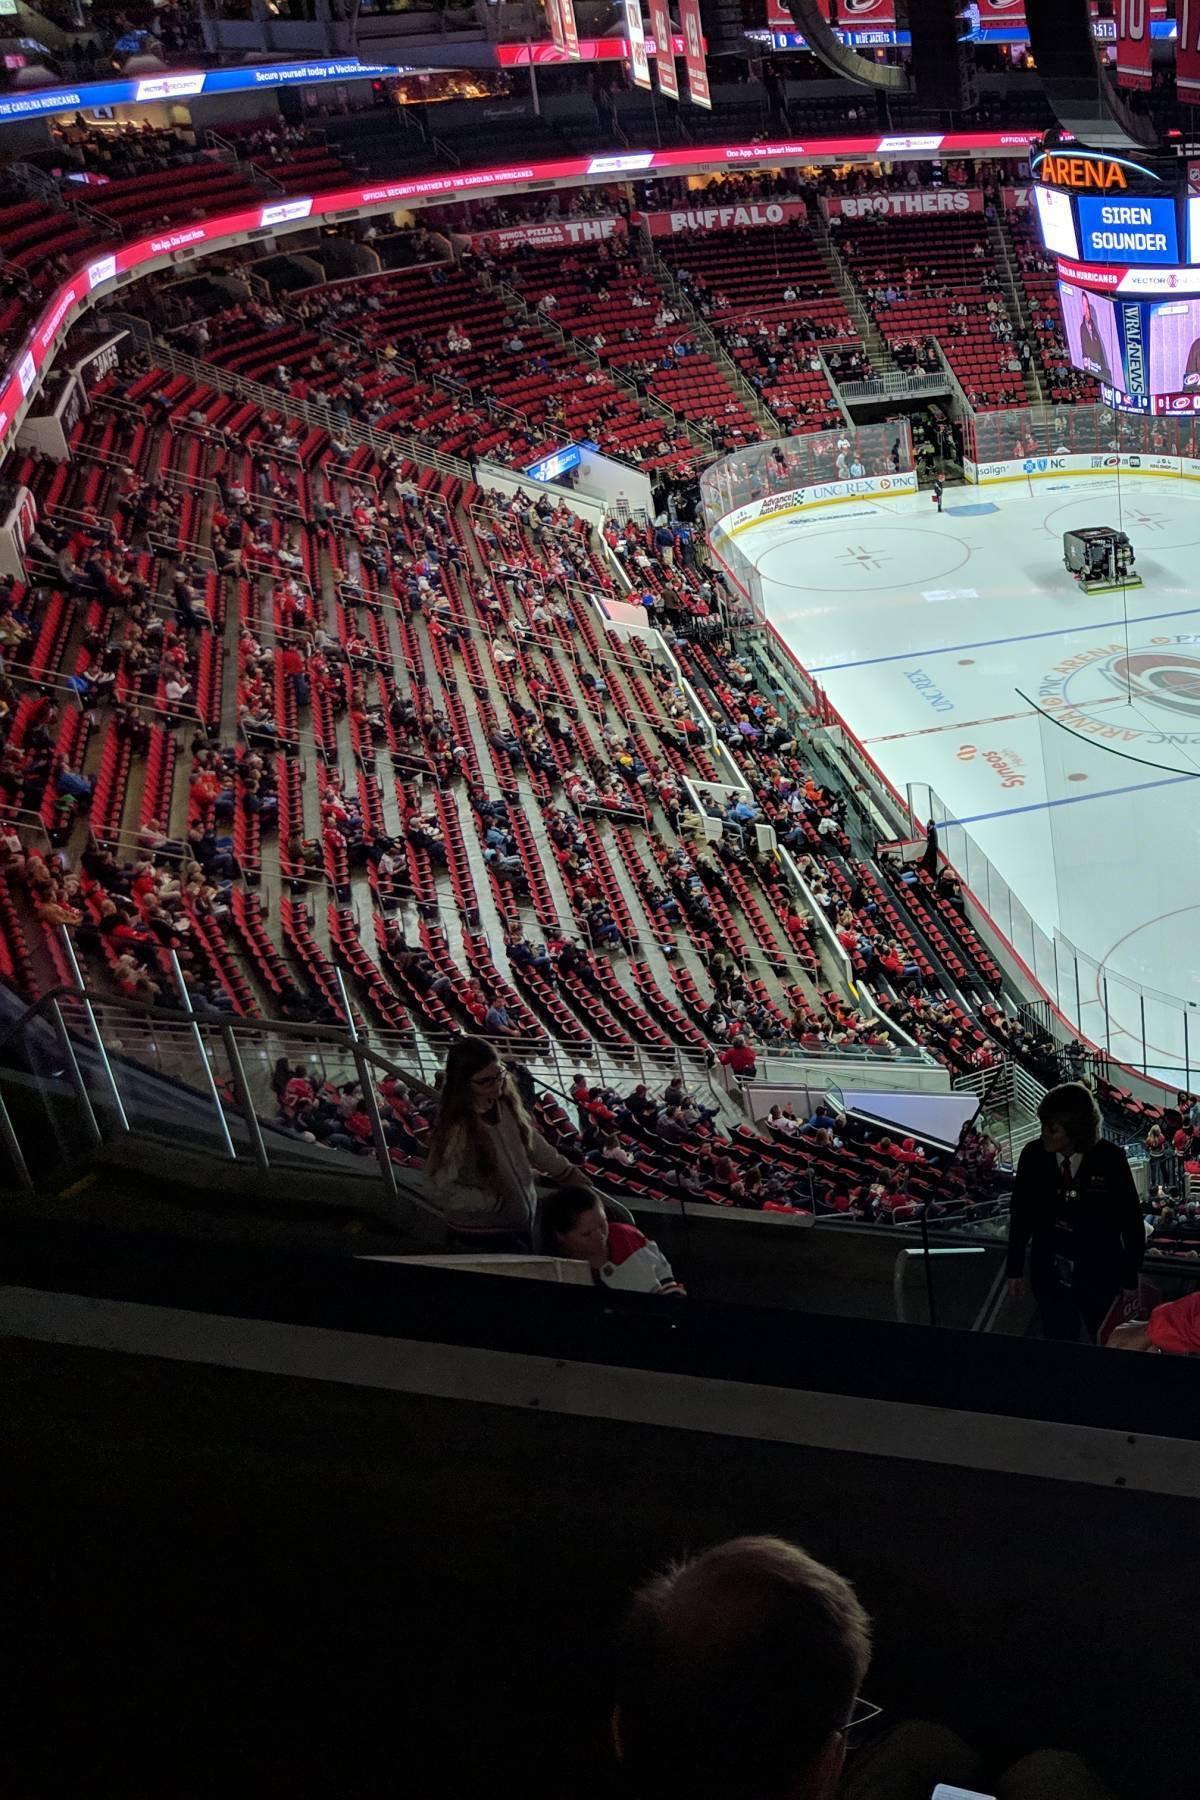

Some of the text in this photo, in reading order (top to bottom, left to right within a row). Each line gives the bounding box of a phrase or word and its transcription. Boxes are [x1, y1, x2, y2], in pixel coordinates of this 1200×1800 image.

[256, 72, 279, 82] Secure
[279, 68, 307, 81] yourself
[307, 66, 327, 78] today
[42, 94, 80, 108] HURRICANES
[1001, 136, 1028, 144] OFFICIAL
[739, 149, 753, 158] App.
[754, 148, 766, 156] One
[767, 147, 785, 155] Smart
[785, 145, 804, 154] Home.
[1041, 159, 1127, 188] ARENA
[840, 193, 970, 217] BROTHERS
[671, 204, 784, 232] BUFFALO
[1102, 207, 1151, 225] SIREN
[565, 219, 616, 242] THE
[1092, 232, 1167, 250] SOUNDER
[1076, 269, 1118, 284] HURRICANES
[1193, 395, 1200, 408] 0
[1050, 459, 1066, 469] NC
[813, 480, 875, 499] UNC REX
[893, 477, 915, 488] PNC
[761, 492, 795, 508] Advance
[759, 506, 773, 517] Auto
[1052, 642, 1127, 675] ARENA
[1039, 673, 1062, 698] PNC
[1055, 708, 1143, 742] ARENA
[982, 751, 1026, 789] Syneos
